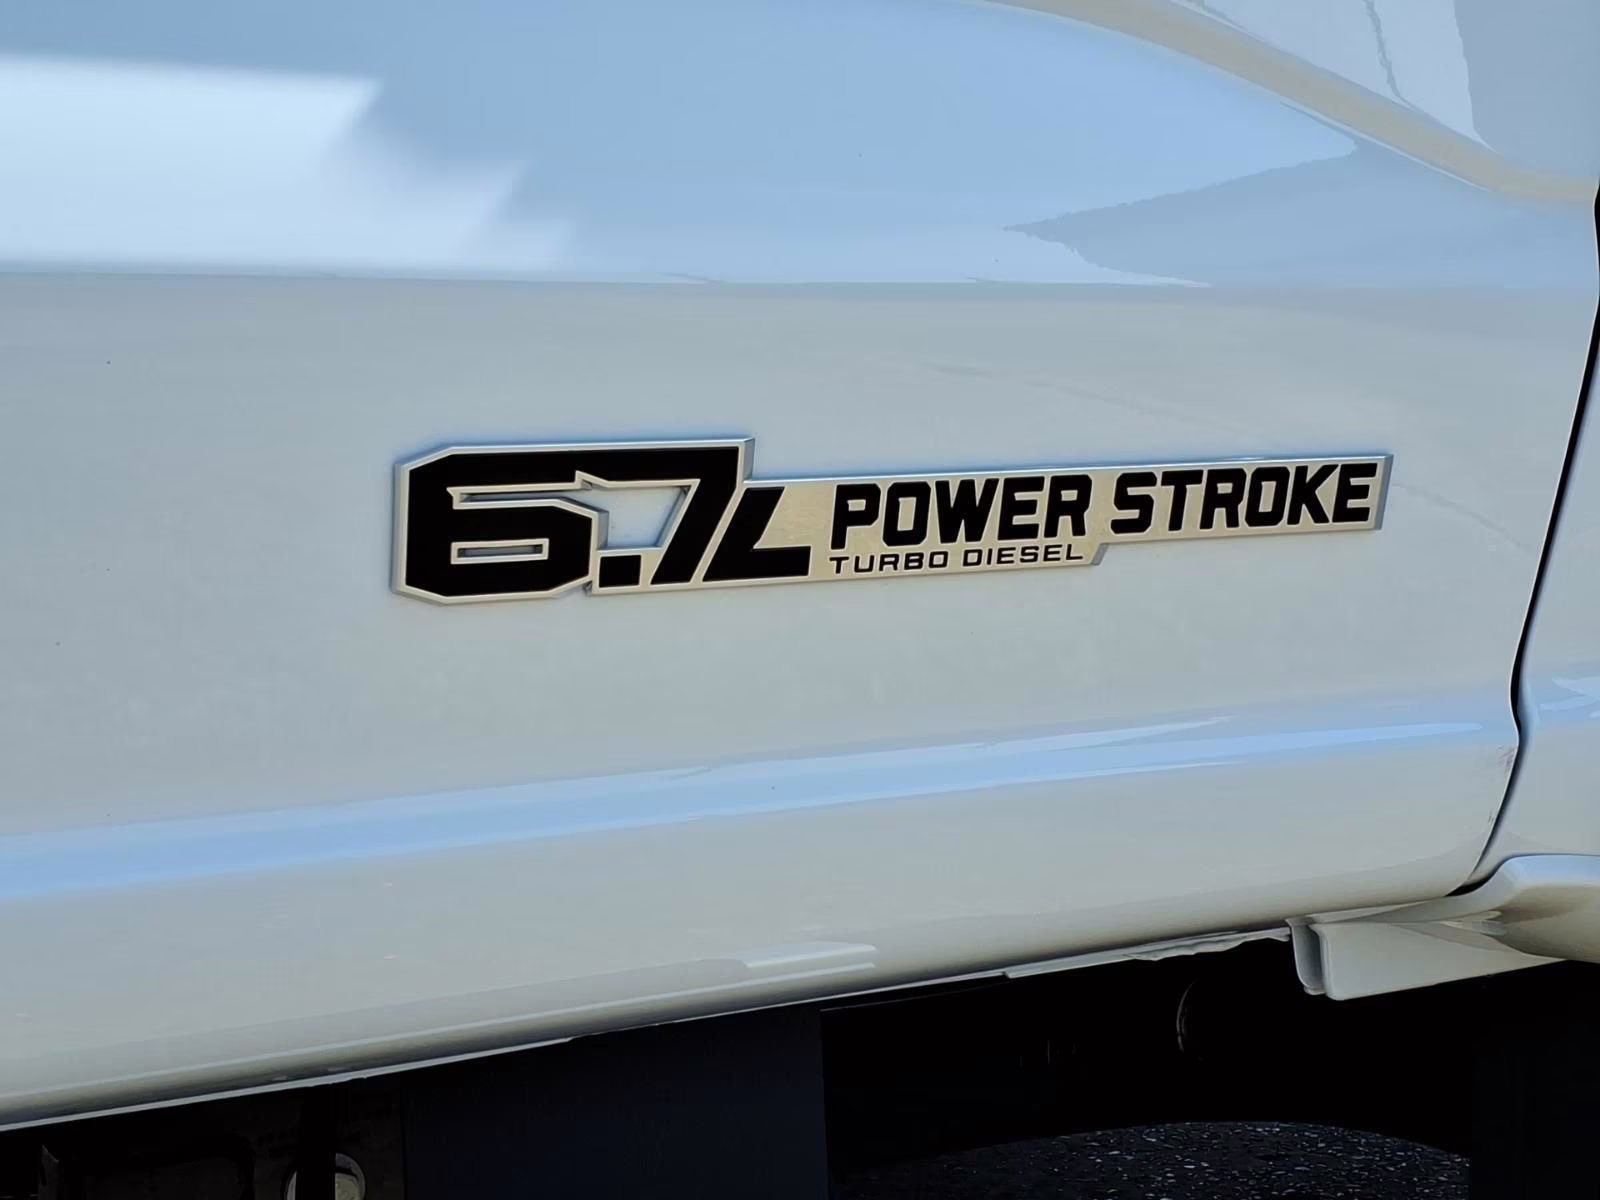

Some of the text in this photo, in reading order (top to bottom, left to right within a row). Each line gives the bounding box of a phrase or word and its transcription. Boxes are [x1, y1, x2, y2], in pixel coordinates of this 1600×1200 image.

[403, 445, 1378, 597] 6.7L POWER STROKE
[829, 543, 1084, 574] TURBO DIESEL
